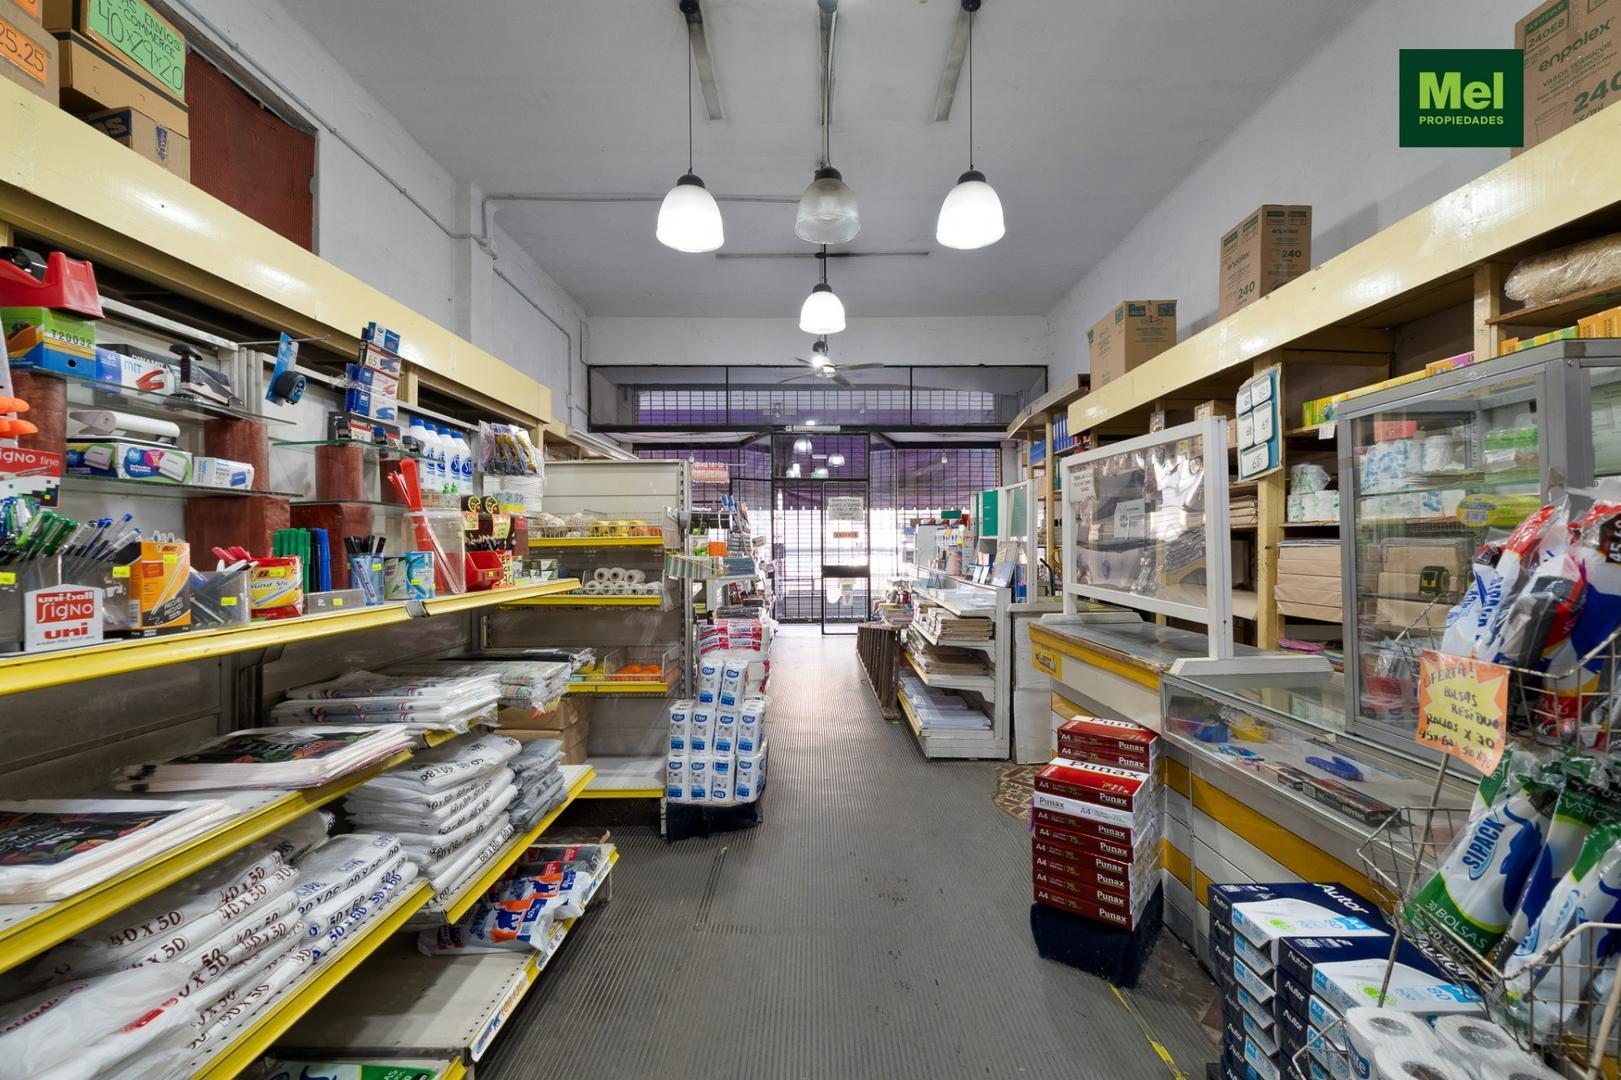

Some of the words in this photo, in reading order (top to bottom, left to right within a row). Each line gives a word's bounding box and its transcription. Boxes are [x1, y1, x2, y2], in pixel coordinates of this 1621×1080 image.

[1539, 20, 1612, 72] enpolex
[1281, 250, 1302, 259] 240
[1238, 281, 1256, 299] 240
[39, 592, 94, 603] uni-ball
[44, 622, 88, 640] uni
[1444, 687, 1478, 707] BOLSAS
[1090, 717, 1144, 731] Puna
[1061, 733, 1071, 741] A4
[1119, 741, 1145, 753] Punax
[1062, 747, 1072, 755] A4
[1119, 757, 1145, 769] Punax
[1070, 761, 1141, 778] Punax
[1038, 781, 1048, 789] A4
[1100, 793, 1127, 806] Punax
[1040, 797, 1065, 808] Punax
[1038, 812, 1048, 820] A4
[1098, 825, 1126, 839] Punax
[1100, 842, 1128, 856] Punax
[1463, 818, 1506, 869] SIPACK
[1036, 843, 1046, 851] A4
[1096, 858, 1123, 872] Punax
[1037, 858, 1047, 866] A4
[1097, 874, 1124, 887] Punax
[221, 903, 241, 920] 40
[249, 884, 267, 902] 50
[1038, 891, 1049, 899] A4
[1099, 908, 1127, 922] Punax
[1097, 890, 1124, 905] Punax
[1319, 884, 1371, 914] Autor
[110, 928, 138, 946] 40
[157, 911, 181, 931] 50
[329, 926, 345, 943] 50
[1213, 919, 1231, 937] Autor
[1436, 907, 1488, 949] BOLSAS
[162, 938, 186, 959] 50
[1215, 944, 1231, 962] Autor
[1287, 950, 1309, 972] Autor
[1284, 980, 1306, 1004] Autor
[1283, 1009, 1304, 1032] Autor
[1227, 1022, 1243, 1042] Autor
